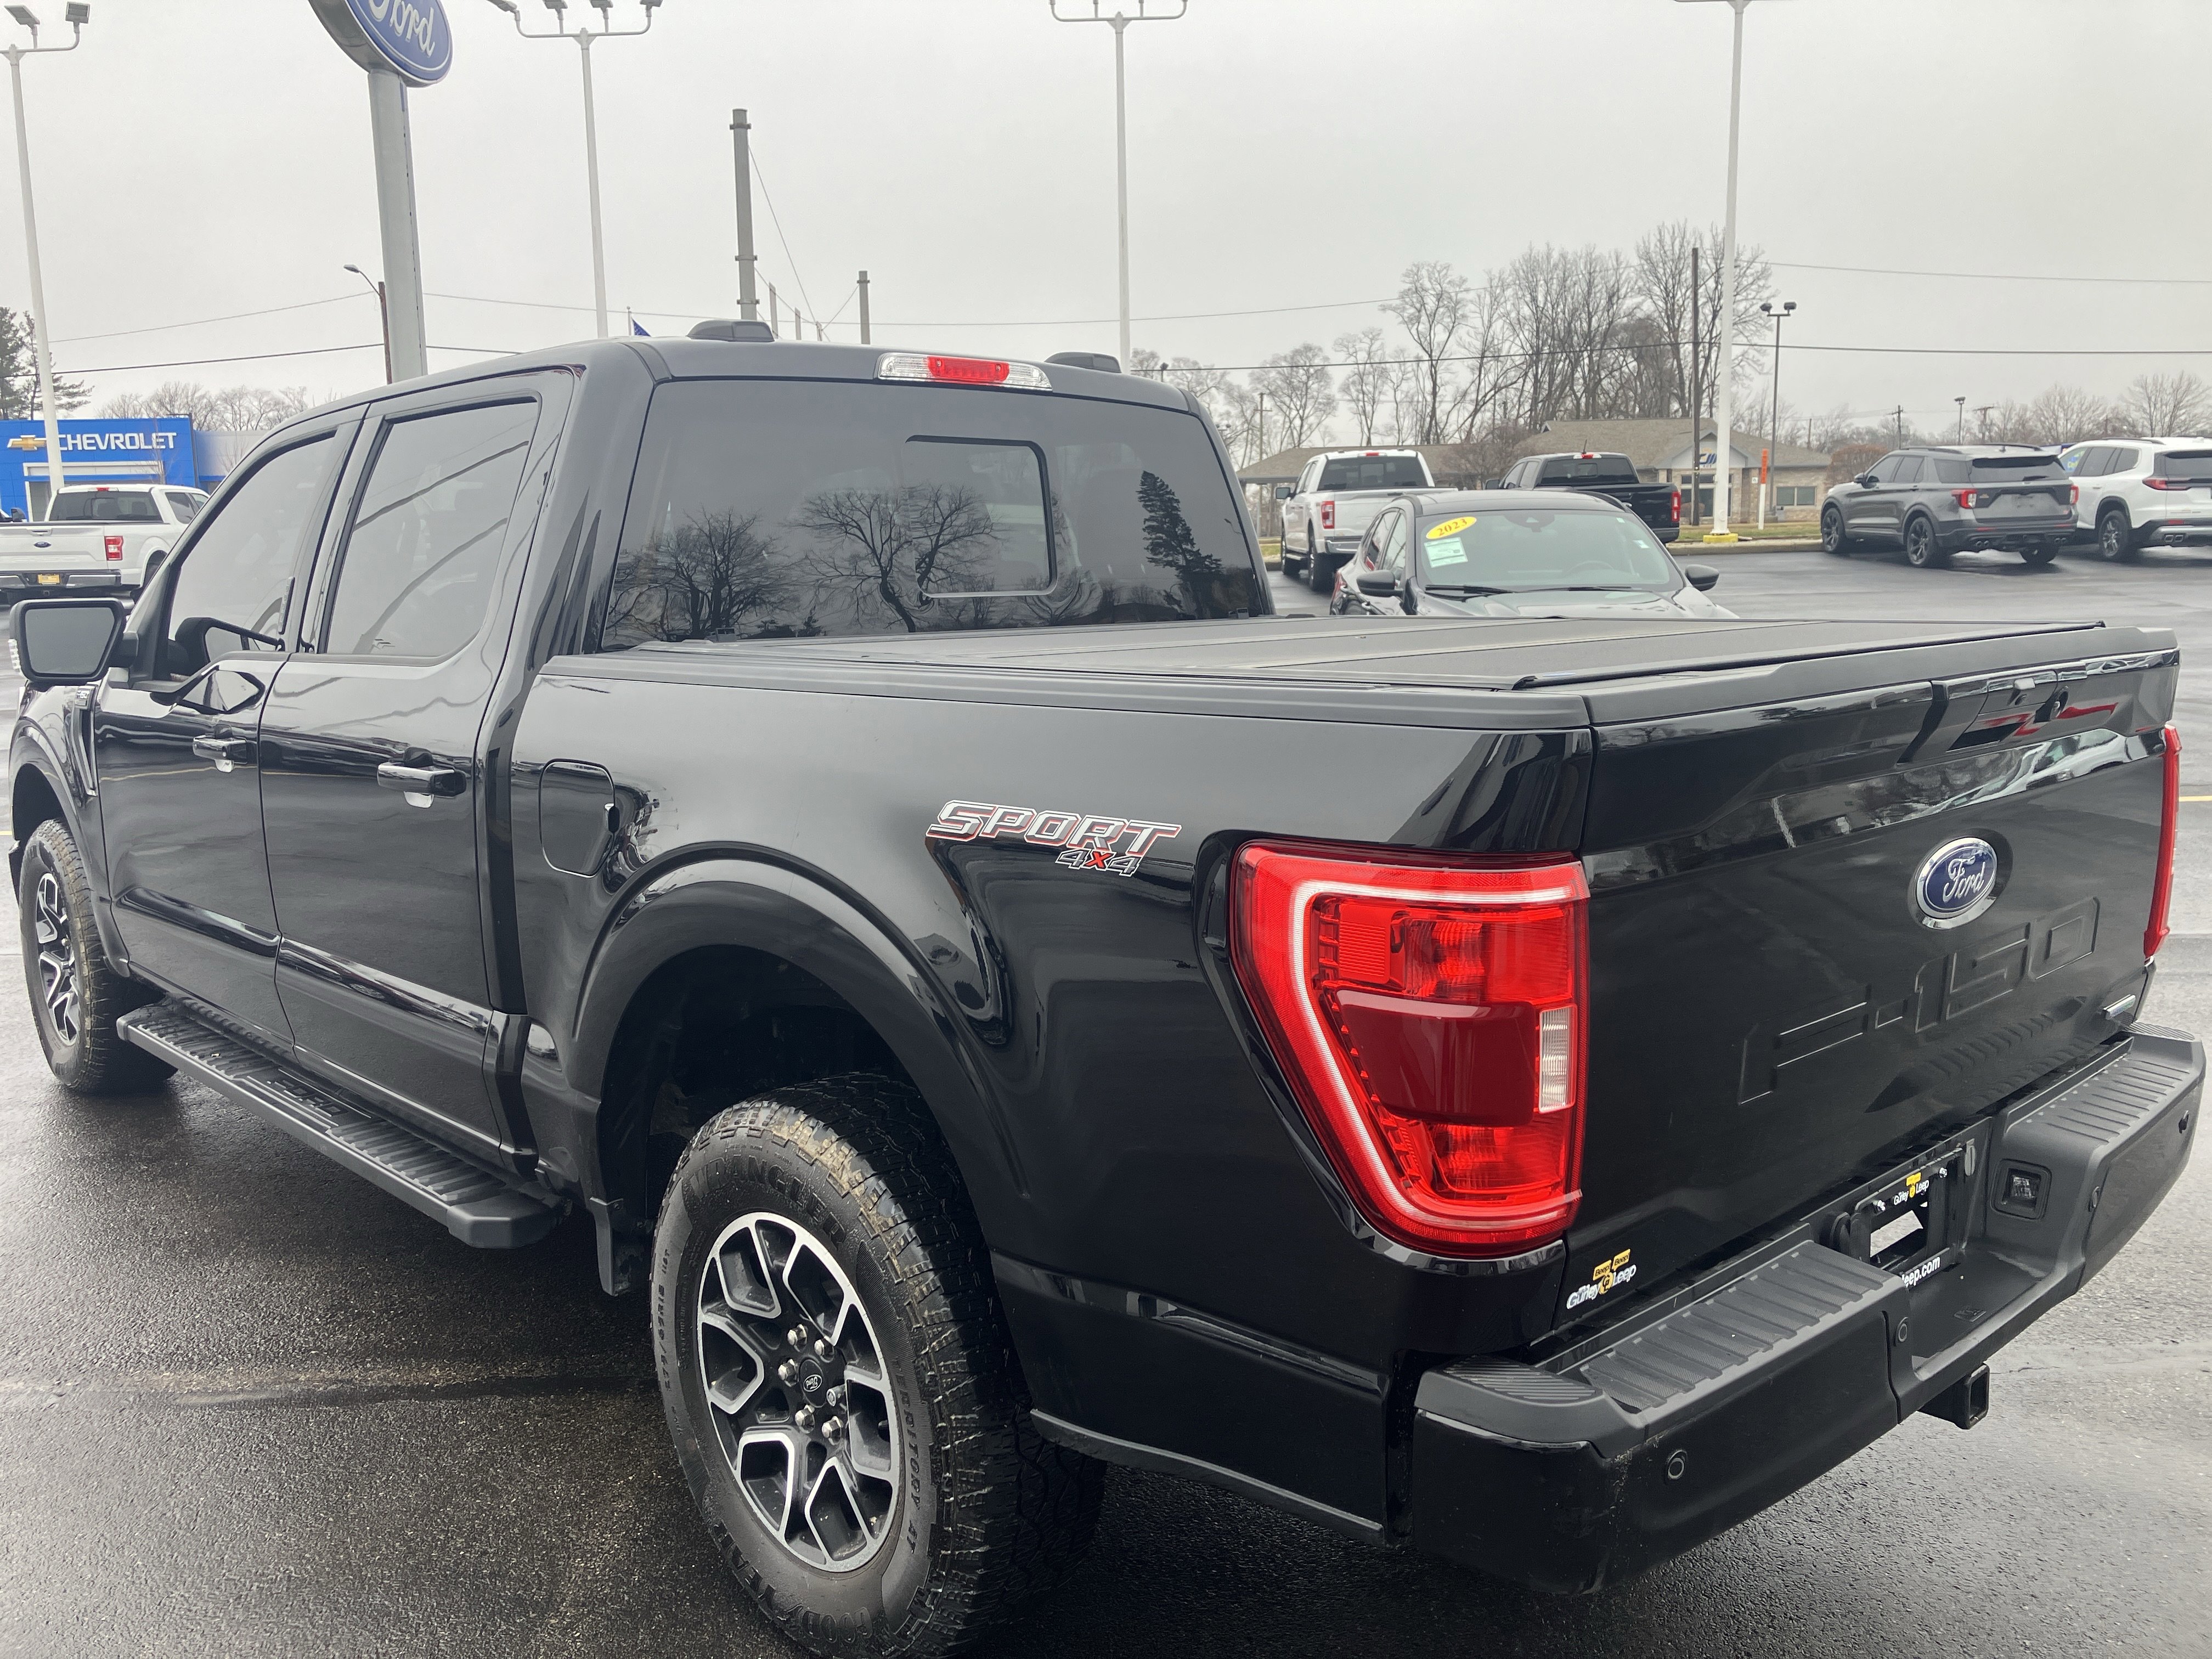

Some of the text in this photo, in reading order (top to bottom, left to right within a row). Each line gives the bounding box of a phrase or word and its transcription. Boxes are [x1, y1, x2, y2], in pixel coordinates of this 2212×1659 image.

[368, 0, 436, 58] ord
[58, 432, 177, 451] CHEVROLET
[1436, 518, 1468, 537] 2023
[926, 799, 1182, 857] SPORT
[1942, 855, 1987, 904] Ford
[1738, 897, 2101, 1105] F-150
[1916, 1180, 1929, 1194] Leep
[1566, 1284, 1601, 1310] Gurley
[1612, 1264, 1637, 1286] Leep
